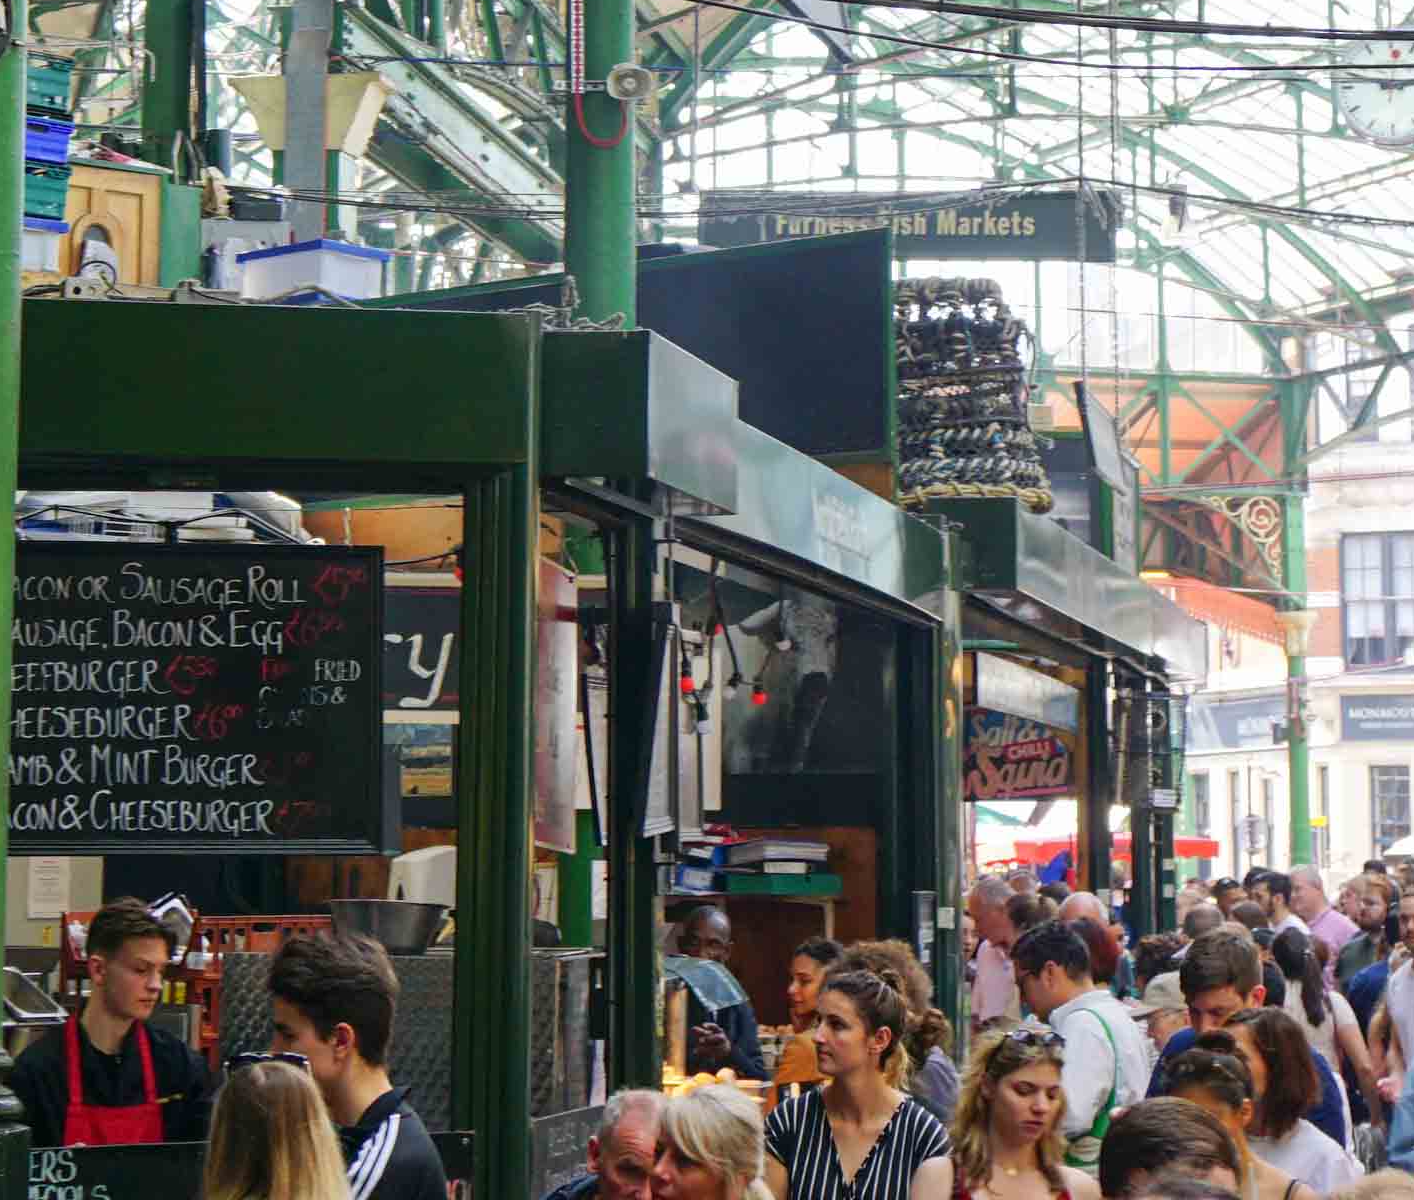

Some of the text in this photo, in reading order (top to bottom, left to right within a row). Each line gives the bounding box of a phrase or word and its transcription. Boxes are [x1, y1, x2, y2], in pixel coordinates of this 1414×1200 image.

[937, 209, 1037, 237] Markets
[12, 575, 76, 600] ACON
[121, 562, 244, 610] SAUSAGE
[248, 565, 307, 610] ROLL
[113, 608, 193, 648] BACON
[199, 614, 225, 647] &
[229, 609, 283, 655] EGG
[11, 659, 171, 697] EEFBURGER
[314, 658, 362, 682] FRIED
[10, 704, 199, 743] HEESEBURGER
[7, 754, 54, 786] AMB
[55, 747, 85, 785] &
[91, 745, 160, 786] MINT
[160, 745, 266, 788] BURGER
[11, 799, 58, 831] CON
[58, 794, 87, 831] &
[89, 789, 276, 836] CHEESEBURGER
[27, 1149, 79, 1184] ERS
